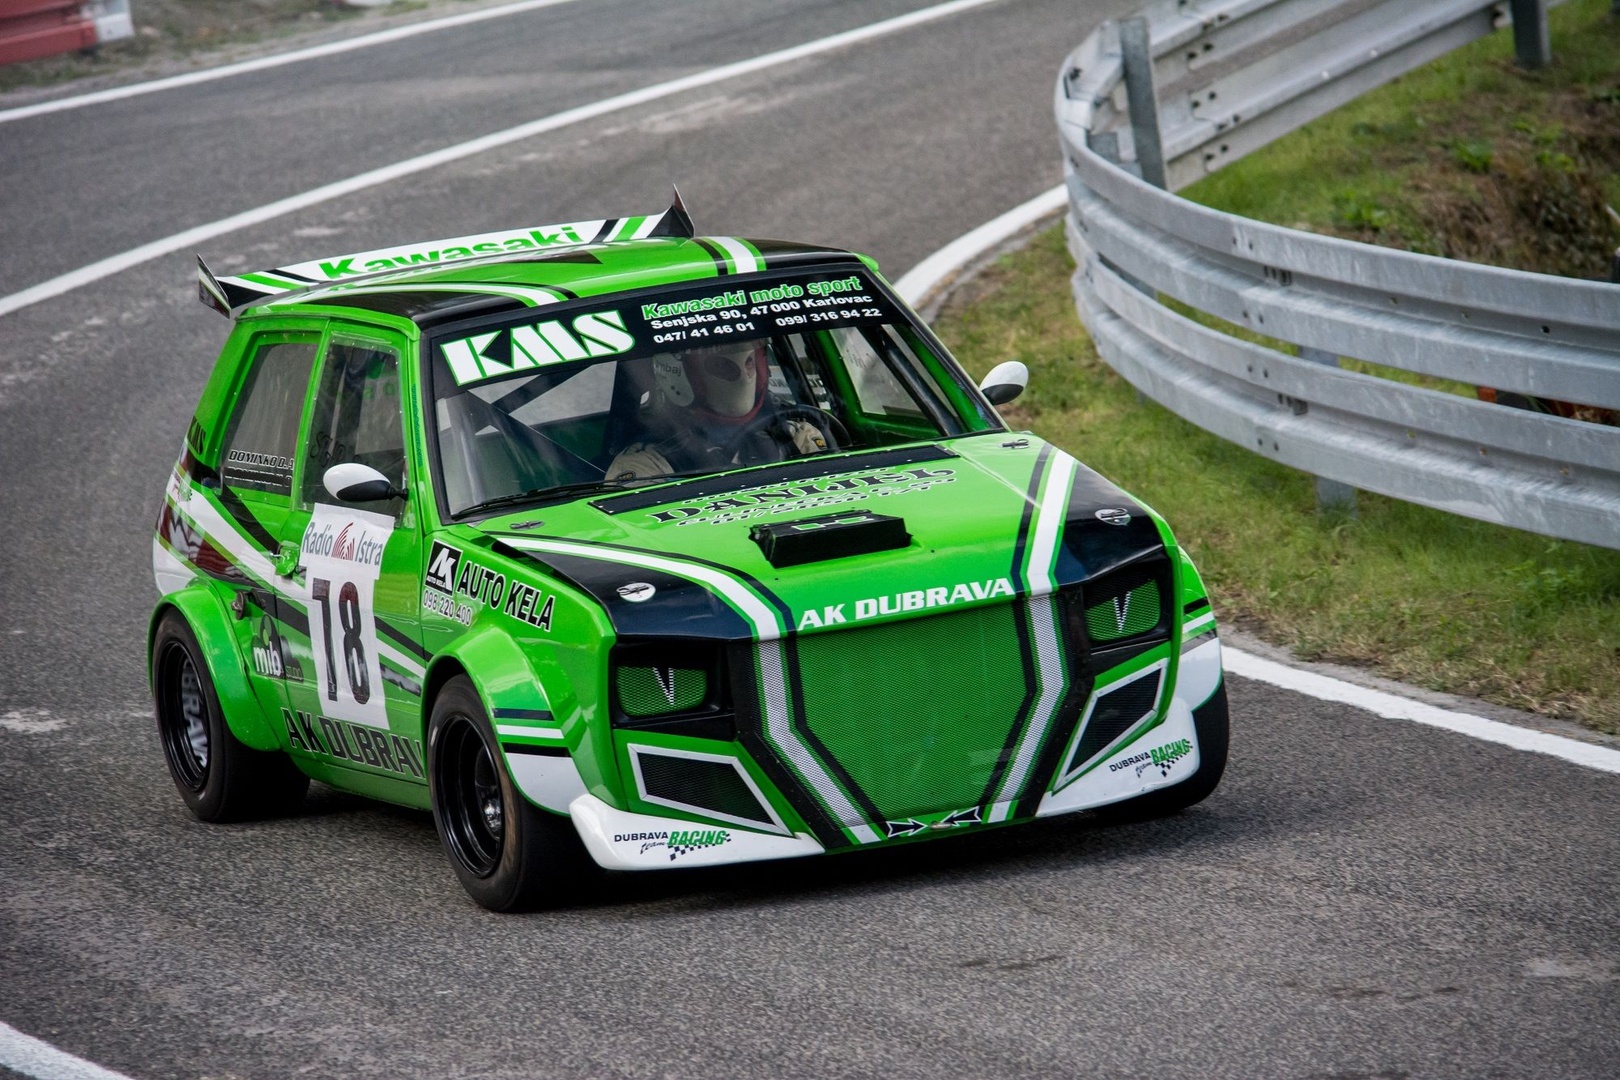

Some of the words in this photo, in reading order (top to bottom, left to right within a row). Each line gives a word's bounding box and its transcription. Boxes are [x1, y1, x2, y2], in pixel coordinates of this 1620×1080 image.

[318, 225, 585, 281] Kawasaki
[641, 290, 747, 320] Kawasaki
[749, 284, 804, 304] moto
[806, 276, 863, 297] sport
[650, 314, 718, 330] Senjska
[719, 309, 748, 320] 90,
[802, 295, 873, 308] Karlovac
[690, 327, 710, 338] 41
[713, 324, 734, 335] 46
[735, 321, 756, 332] 01
[810, 311, 839, 322] 316
[840, 309, 861, 319] 94
[861, 308, 883, 317] 22
[439, 309, 636, 387] KMS
[228, 449, 278, 468] DOMINKO
[645, 468, 957, 522] DANIJEL
[302, 521, 333, 557] Radio
[354, 530, 384, 566] Istra
[438, 596, 455, 620] 220
[455, 603, 473, 627] 400
[456, 560, 506, 610] AUTO
[503, 579, 556, 633] KELA
[797, 603, 847, 631] AK
[855, 577, 1016, 620] DUBRAVA
[281, 707, 329, 756] AK
[1109, 751, 1152, 773] DUBRAVA
[1150, 738, 1191, 764] RACING
[614, 831, 669, 842] DUBRAVA
[666, 830, 727, 846] RACING
[639, 842, 667, 855] team
